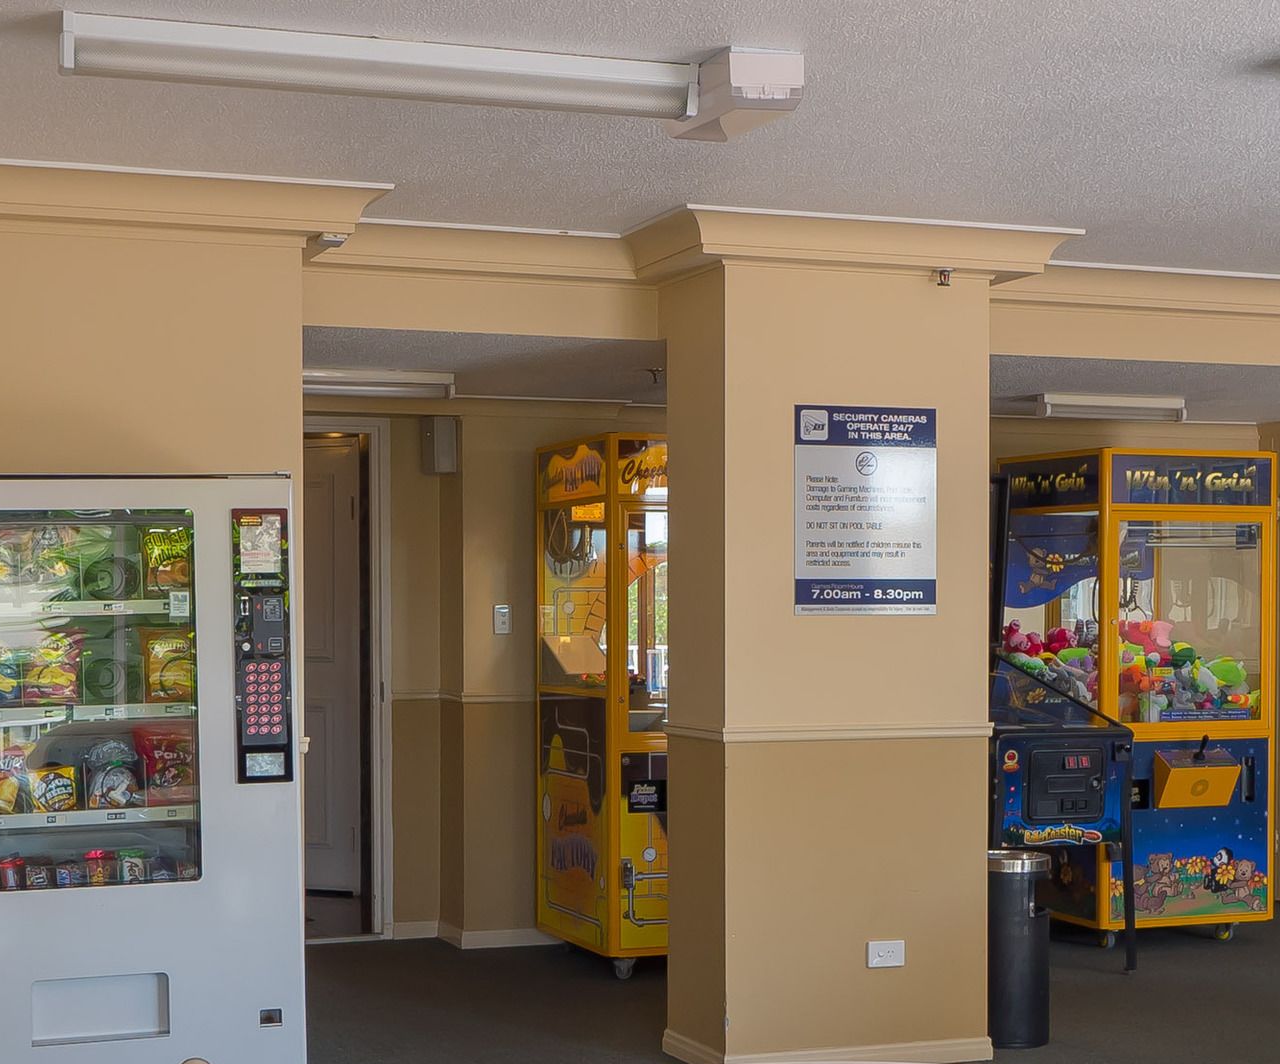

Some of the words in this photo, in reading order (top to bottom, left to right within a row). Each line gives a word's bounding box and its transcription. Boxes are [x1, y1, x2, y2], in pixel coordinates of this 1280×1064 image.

[833, 413, 879, 421] SECURITY
[881, 414, 927, 423] CAMERAS
[847, 422, 890, 431] OPERATE
[892, 423, 914, 432] 24/7
[848, 431, 858, 439] IN
[860, 432, 882, 440] THIS
[883, 432, 912, 440] AREA.
[1125, 470, 1171, 490] Win
[1205, 472, 1255, 491] Grin
[806, 485, 829, 494] Damage
[837, 485, 858, 494] Gaming
[806, 494, 832, 503] Computer
[821, 504, 849, 512] regardless
[865, 522, 882, 530] TABLE
[806, 540, 826, 548] Parents
[827, 540, 836, 548] will
[837, 540, 844, 548] be
[846, 540, 864, 548] notified
[831, 550, 859, 559] equipment
[872, 551, 883, 559] may
[806, 559, 830, 567] restricted
[811, 589, 861, 599] 7.00am
[873, 589, 924, 601] 8.30pm
[153, 750, 193, 763] Party
[630, 792, 658, 804] Depot
